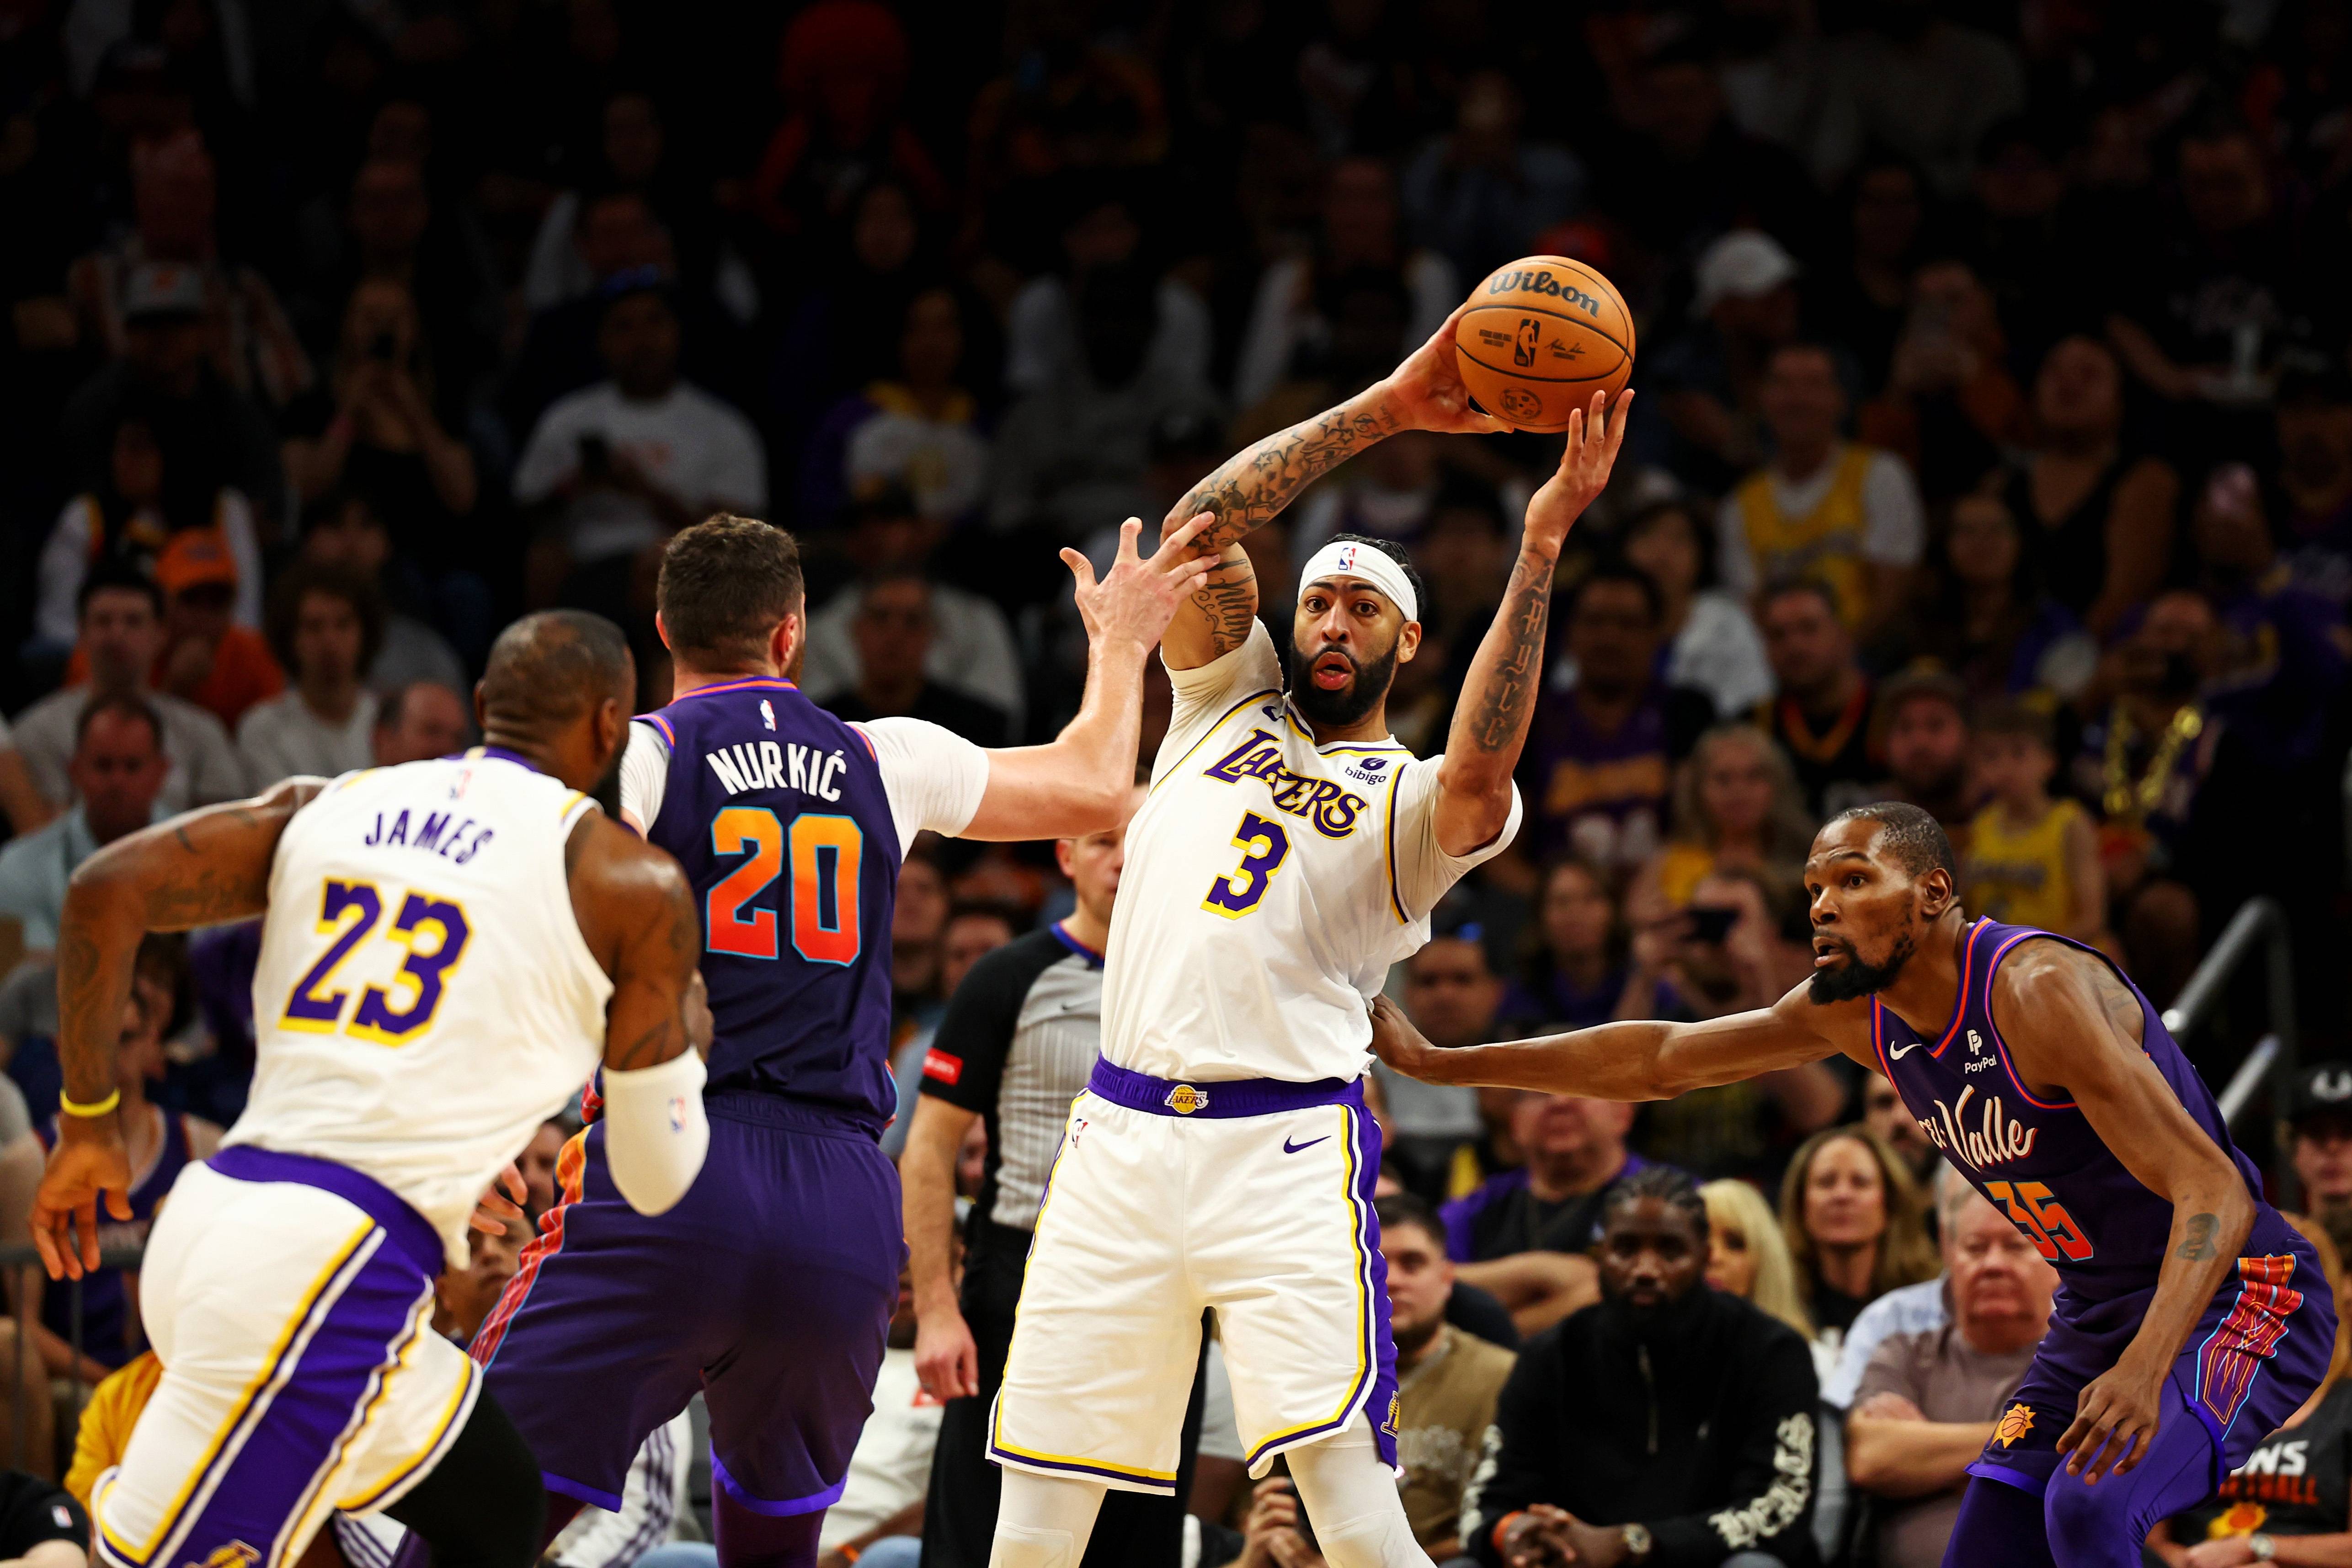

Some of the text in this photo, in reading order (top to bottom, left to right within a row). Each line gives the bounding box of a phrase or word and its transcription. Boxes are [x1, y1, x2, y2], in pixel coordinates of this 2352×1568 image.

[1489, 271, 1600, 318] Wilson
[706, 741, 847, 803] NURKIĆ
[1200, 728, 1369, 840] LAKERS
[1344, 766, 1387, 785] bibigo
[365, 808, 494, 865] JAMES
[1200, 809, 1292, 921] 3
[706, 805, 864, 968] 20
[276, 875, 475, 1048] 23
[1964, 1054, 1997, 1074] PayPal
[1933, 1083, 2039, 1174] Valle
[1983, 1179, 2094, 1262] 35
[2230, 1440, 2309, 1476] NS
